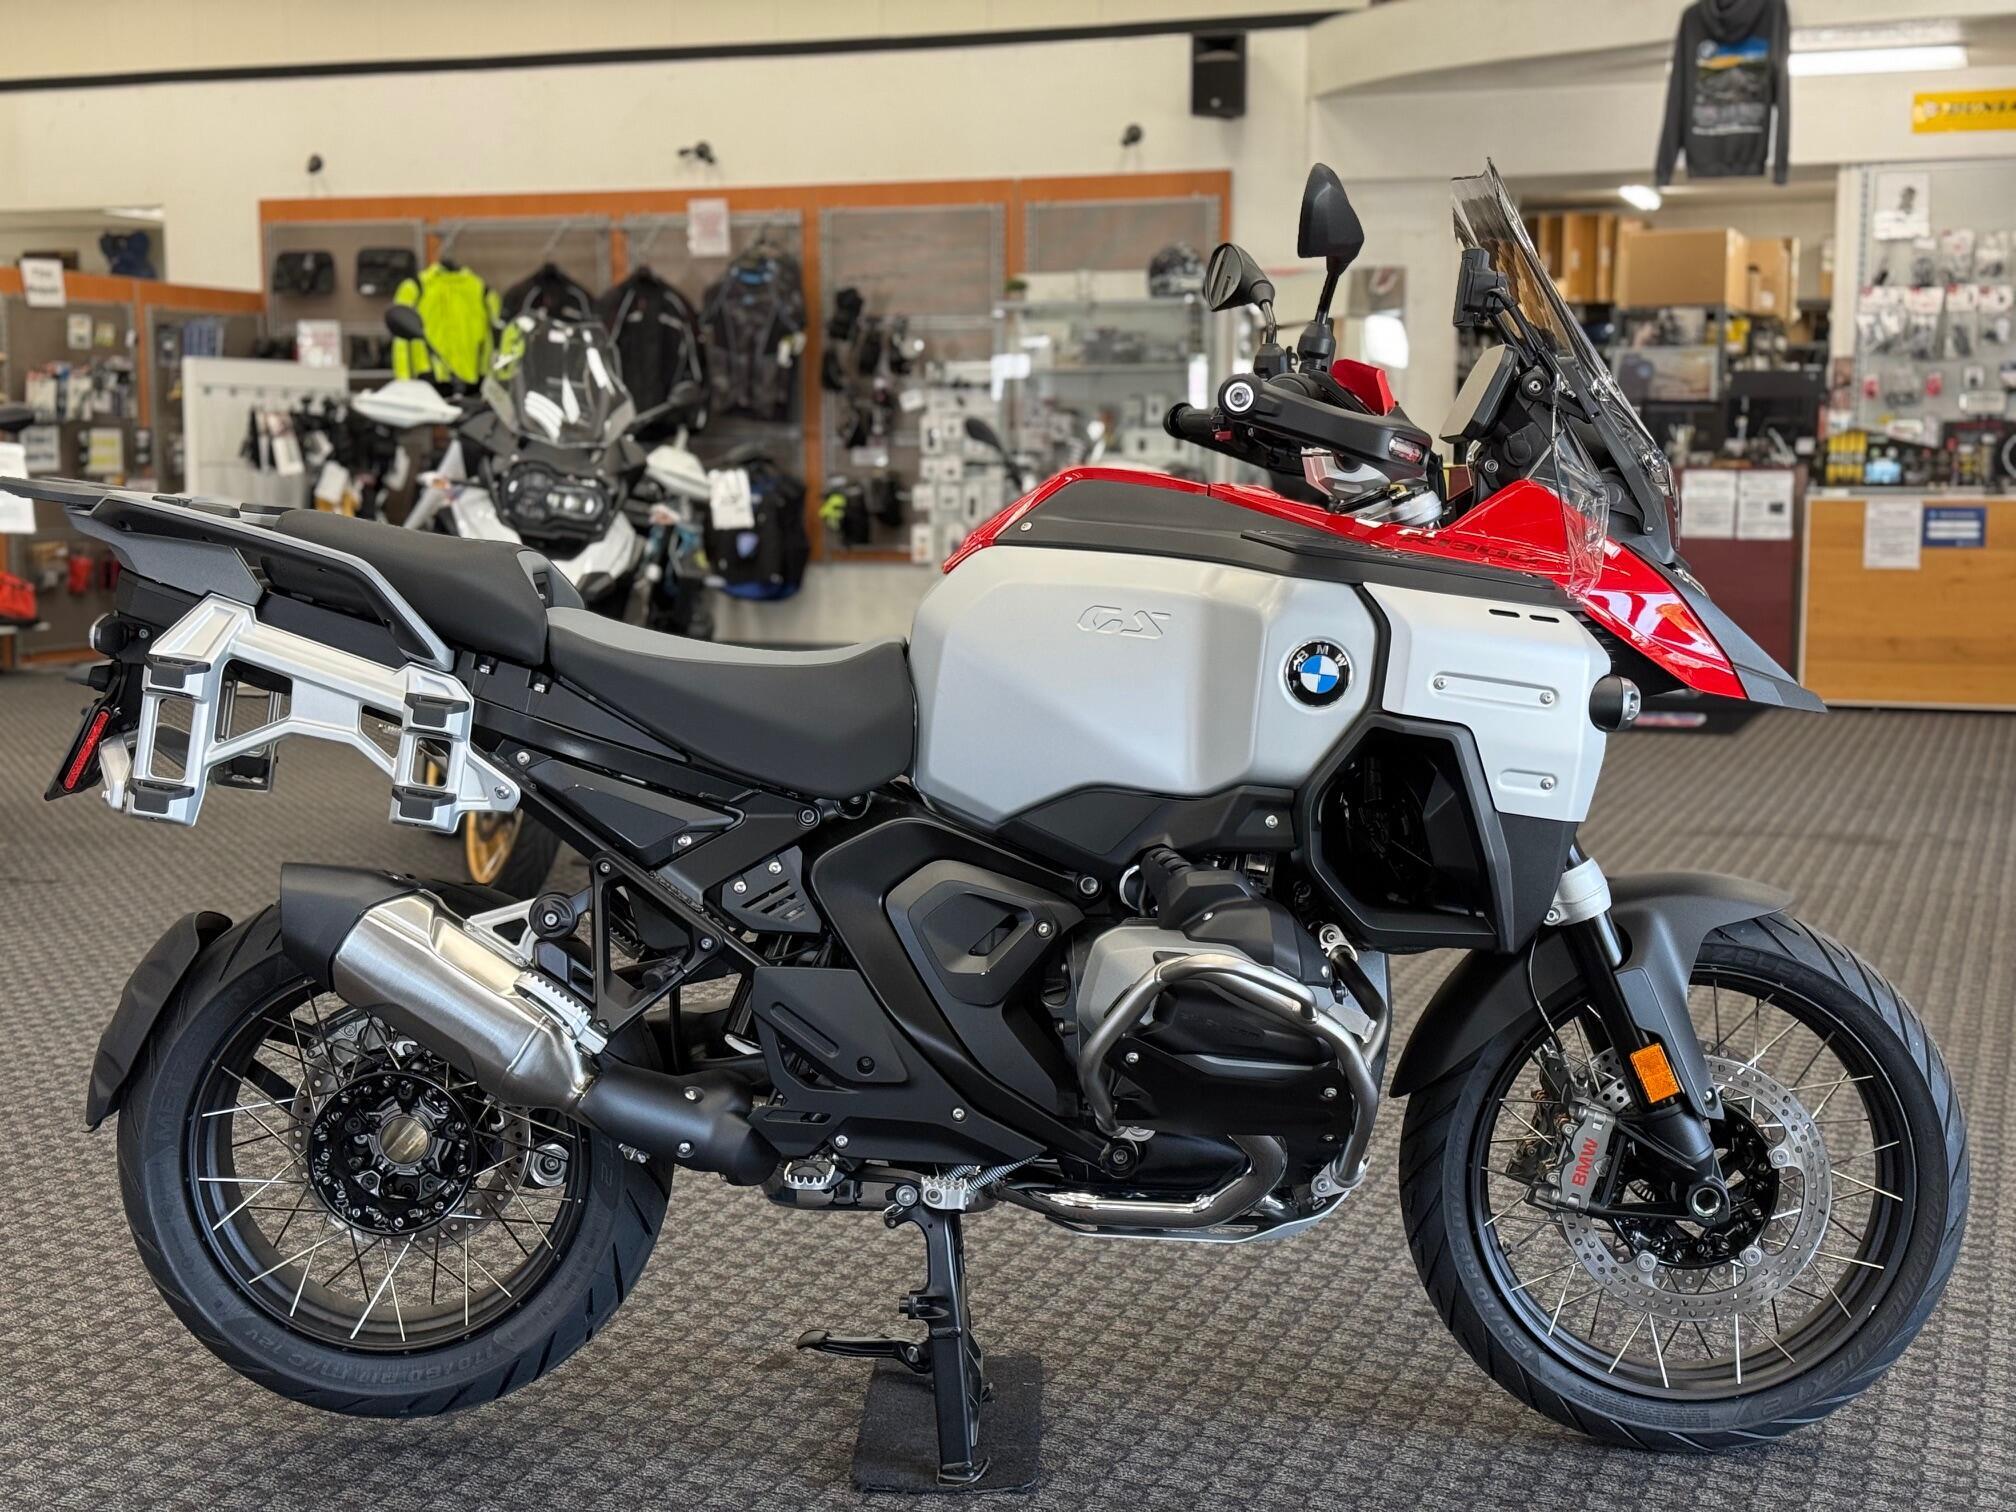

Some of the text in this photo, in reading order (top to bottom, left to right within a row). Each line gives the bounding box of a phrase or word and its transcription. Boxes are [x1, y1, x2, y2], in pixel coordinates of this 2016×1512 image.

[1076, 604, 1171, 640] GS
[1296, 644, 1346, 666] BMW
[1572, 1137, 1598, 1186] BMW
